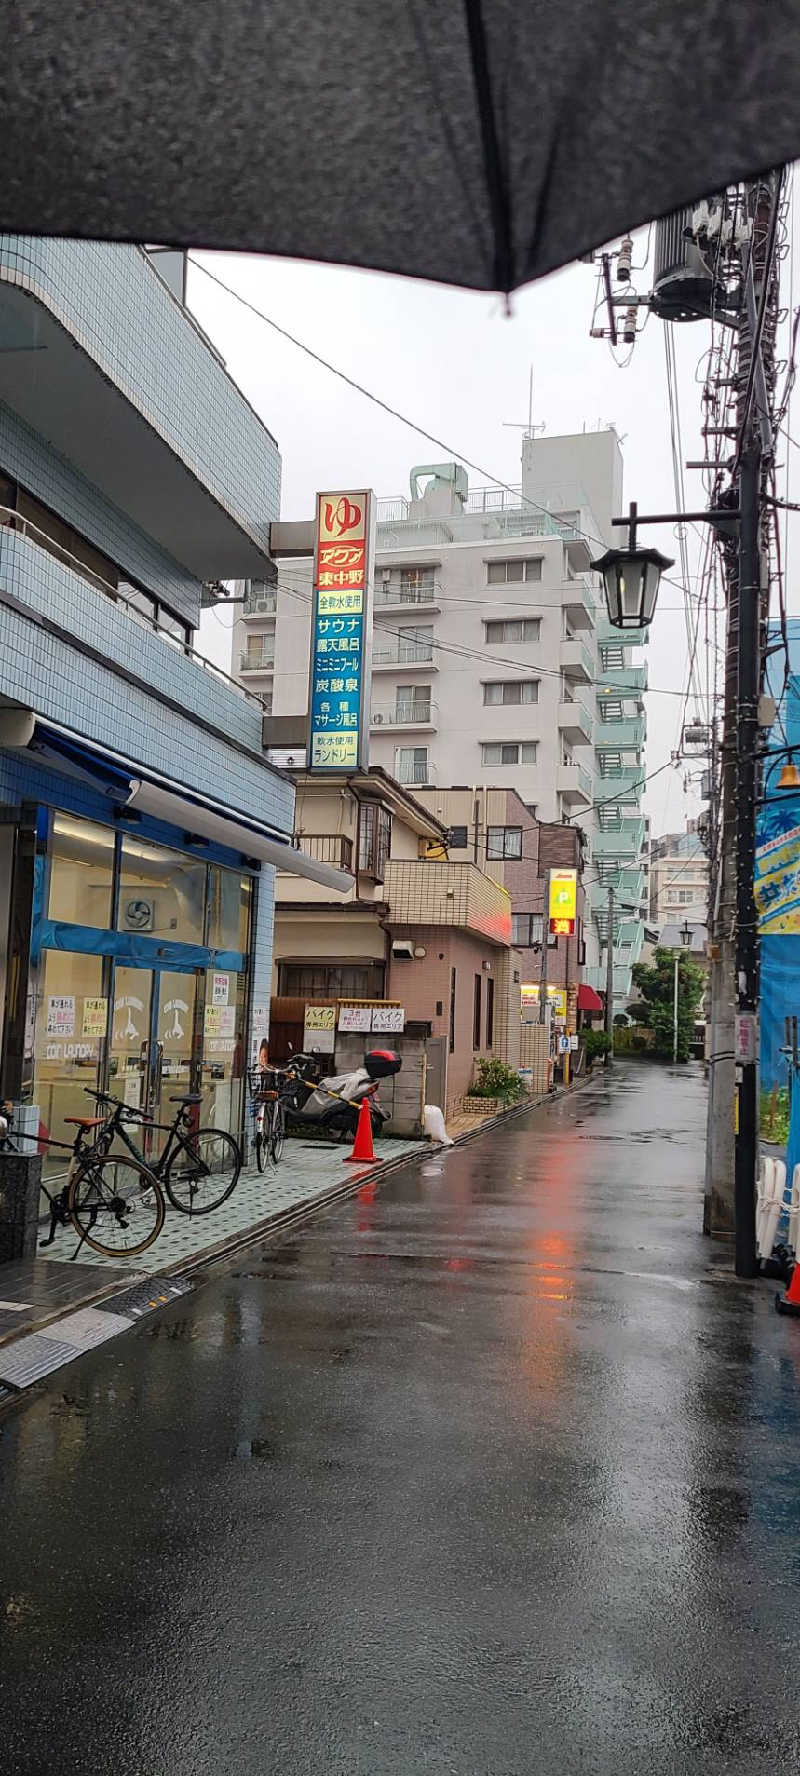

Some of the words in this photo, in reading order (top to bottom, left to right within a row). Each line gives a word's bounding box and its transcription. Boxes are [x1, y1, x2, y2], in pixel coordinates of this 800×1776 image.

[324, 497, 361, 538] ゆ
[319, 570, 364, 586] 東中野
[319, 595, 361, 609] 全軟水使用
[318, 618, 360, 634] サウナ
[317, 638, 360, 652] 露天風呂
[315, 678, 358, 693] 炭酸泉
[313, 748, 356, 763] ランドリー
[306, 1009, 334, 1020] バイク
[374, 1011, 402, 1022] バイク
